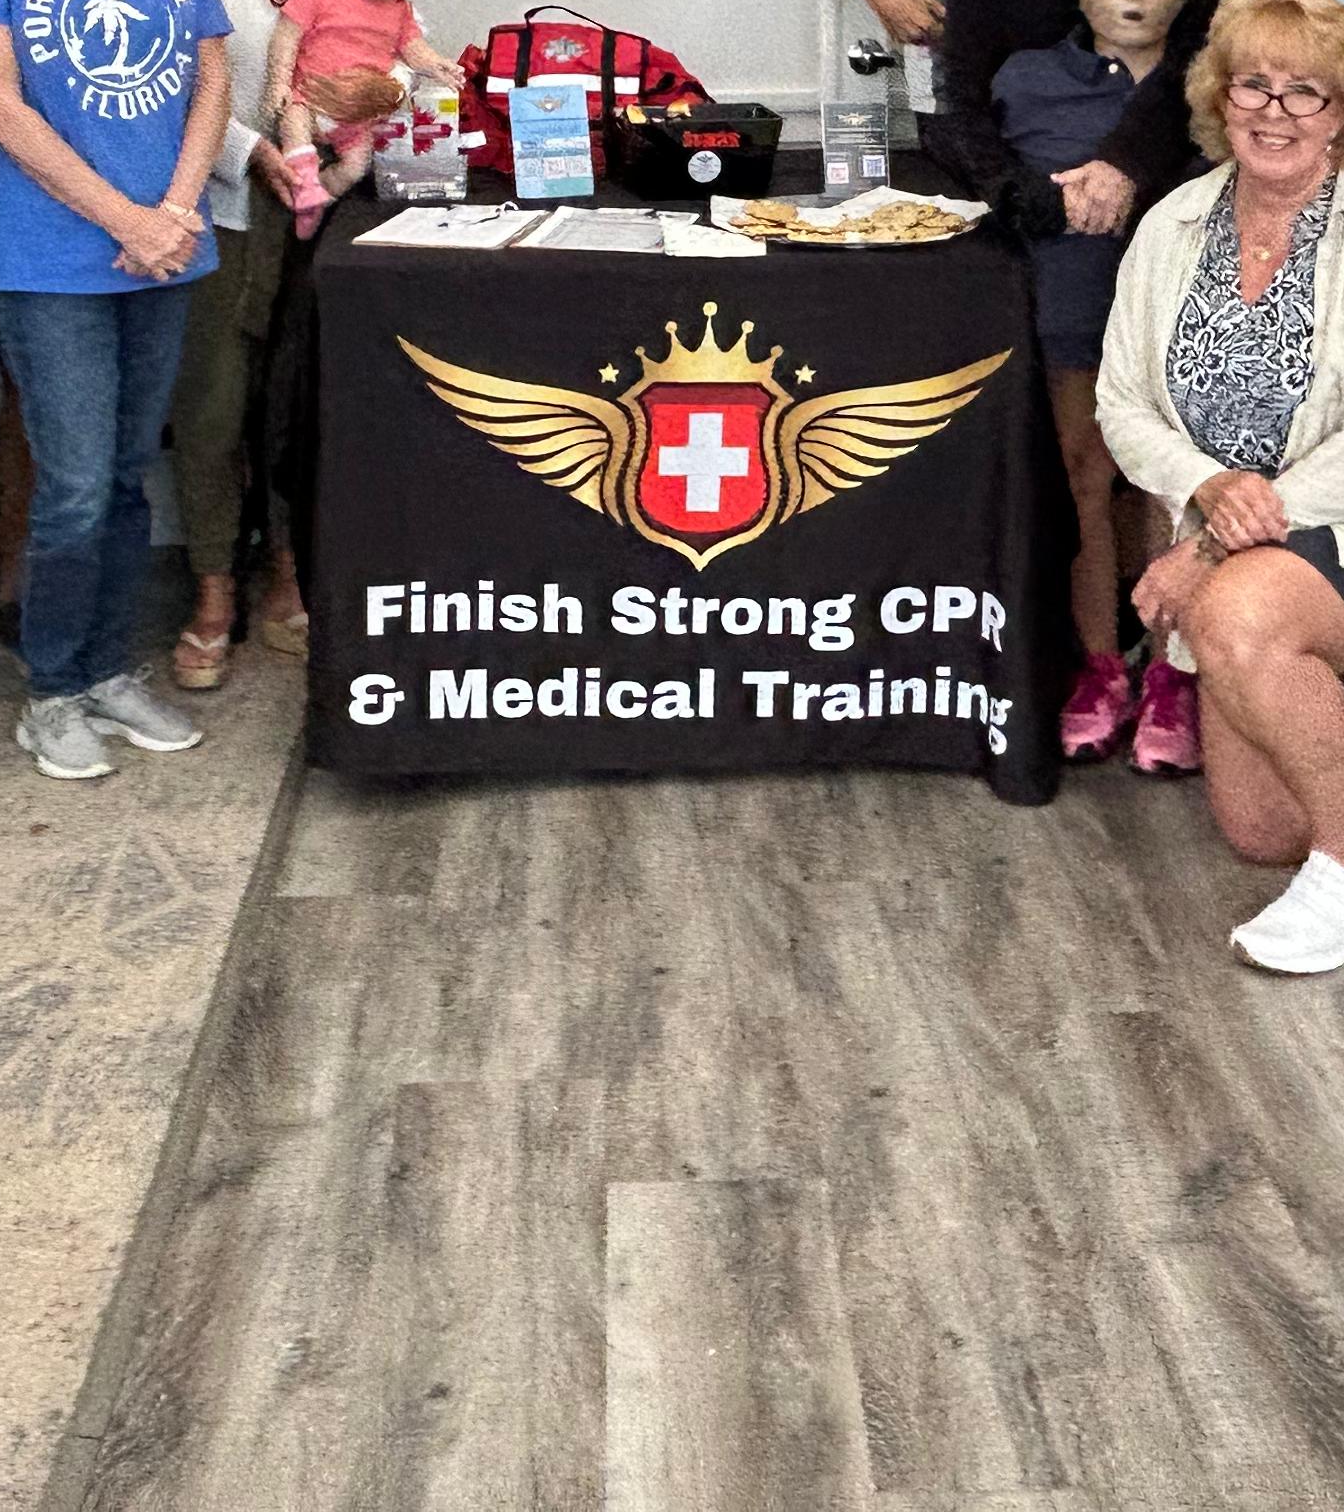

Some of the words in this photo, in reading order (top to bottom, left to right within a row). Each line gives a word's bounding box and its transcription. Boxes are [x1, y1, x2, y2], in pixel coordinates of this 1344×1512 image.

[81, 49, 194, 121] FLORIDA
[367, 580, 582, 635] Finish
[611, 586, 856, 651] Strong
[881, 586, 1005, 652] CPR
[349, 674, 405, 725] &
[430, 668, 714, 719] Medical
[742, 666, 1012, 754] Training
